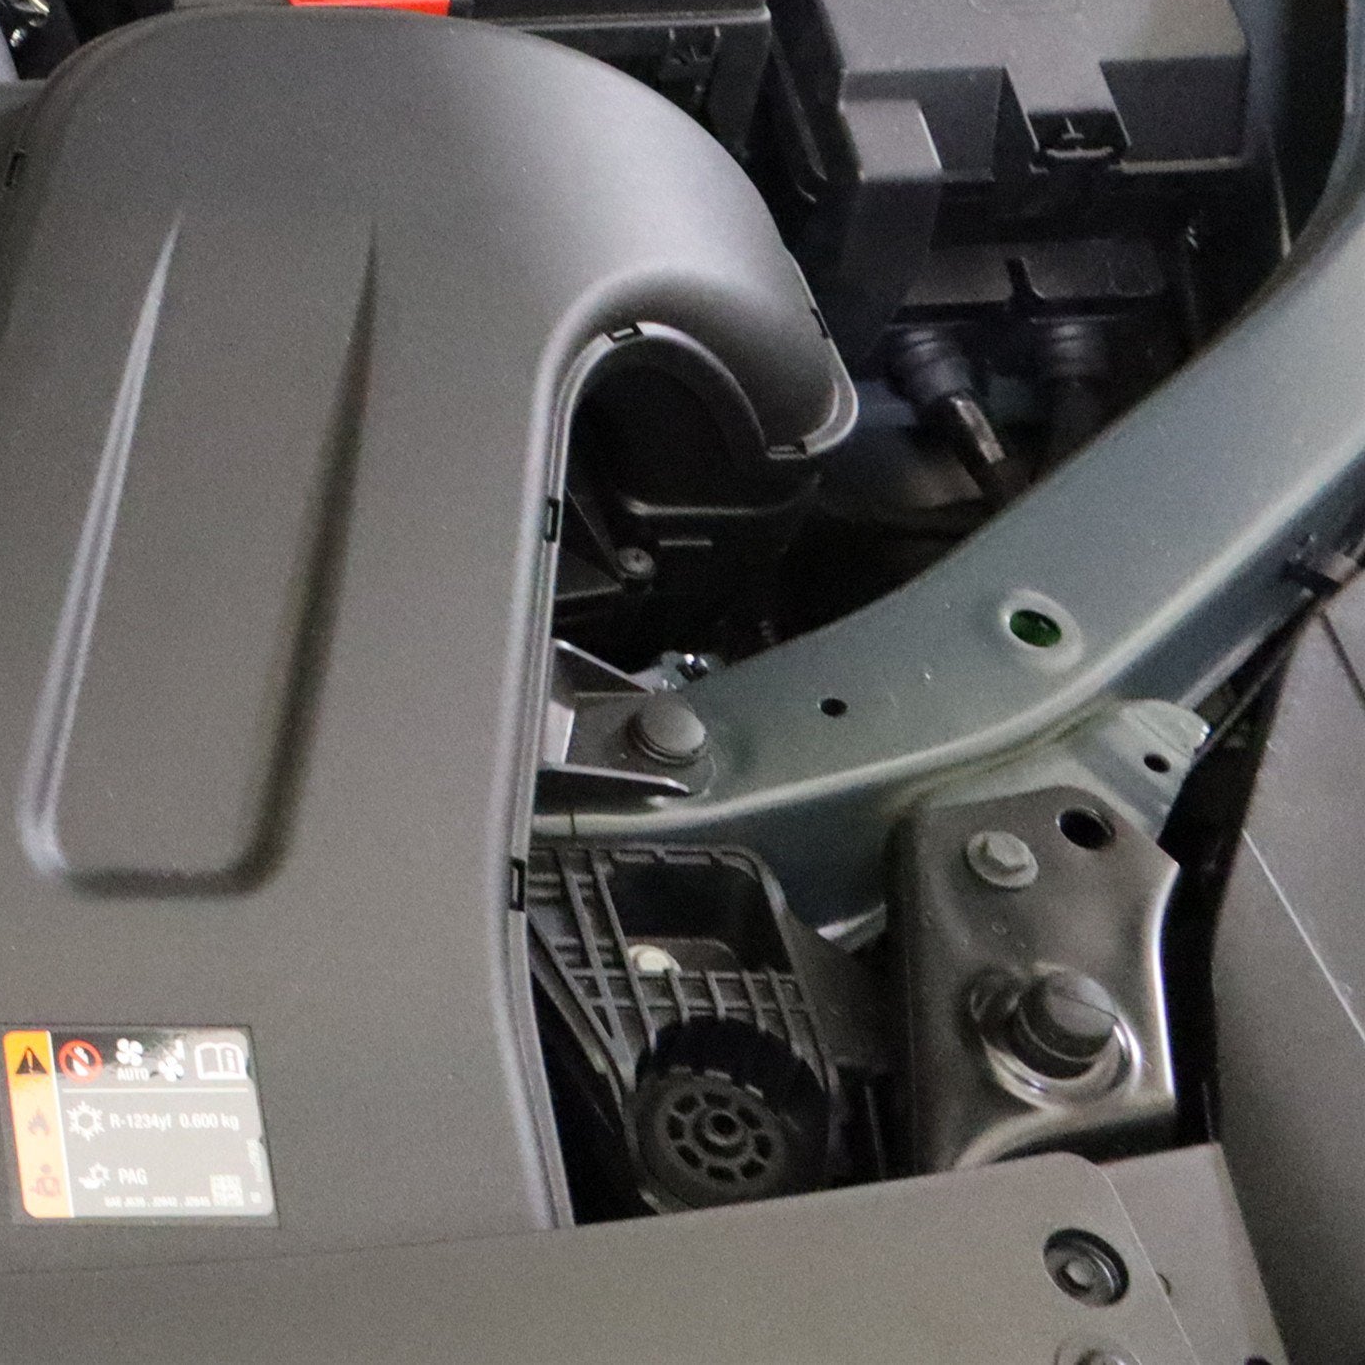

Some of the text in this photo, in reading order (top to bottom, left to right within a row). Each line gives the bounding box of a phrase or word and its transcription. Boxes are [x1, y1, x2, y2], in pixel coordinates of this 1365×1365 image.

[116, 1068, 149, 1081] AUTO
[109, 1112, 240, 1132] R-1234yf 0.600 kg
[118, 1168, 148, 1185] PAG
